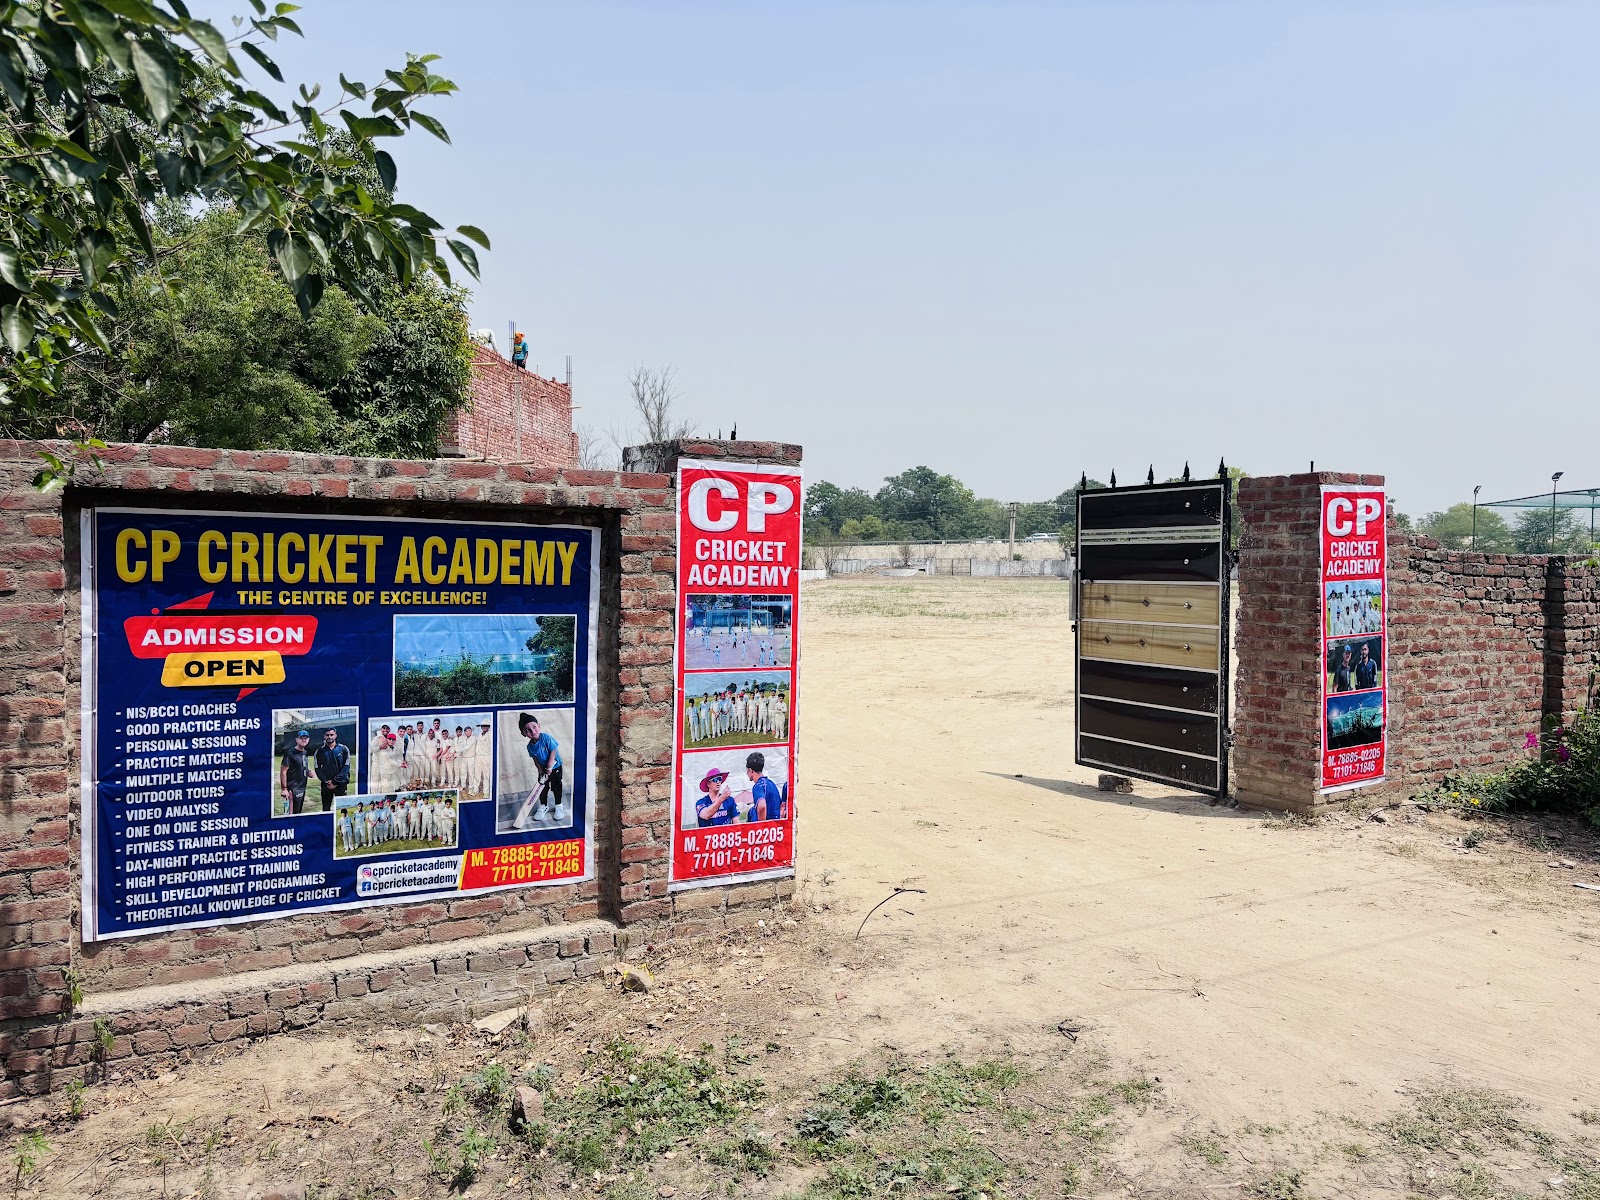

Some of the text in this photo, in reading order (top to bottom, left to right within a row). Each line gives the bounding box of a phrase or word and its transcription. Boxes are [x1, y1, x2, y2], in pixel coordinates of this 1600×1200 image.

[688, 477, 794, 533] CP
[1326, 497, 1382, 537] CP
[115, 527, 580, 586] CP CRICKET ACADEMY
[695, 538, 786, 562] CRICKET
[1330, 540, 1378, 558] CRICKET
[687, 564, 792, 587] ACADEMY
[1326, 558, 1382, 576] ACADEMY
[237, 590, 487, 606] THE CENTRE OF EXCELLENCE!
[140, 626, 304, 646] ADMISSION
[184, 659, 265, 678] OPEN
[126, 702, 237, 720] NIS/BCCI COACHES
[126, 718, 261, 736] GOOD PRACTICE AREAS
[126, 734, 247, 753] PERSONAL SESSIONS
[126, 752, 244, 770] PRACTICE MATCHES
[1328, 748, 1381, 767] M. 78885-02205
[126, 768, 242, 788] MULTIPLE MATCHES
[1333, 761, 1376, 778] 77101-71846
[126, 786, 225, 804] OUTDOOR TOURS
[126, 802, 220, 821] VIDEO ANALYSIS
[126, 816, 249, 838] ONE ON ONE SESSION
[126, 828, 295, 856] FITNESS TRAINER & DIETITIAN
[684, 826, 784, 852] M. 78885-02205
[126, 844, 304, 872] DAY-NIGHT PRACTICE SESSIONS
[471, 841, 580, 867] M. 78885-02205
[693, 845, 774, 870] 77101-71846
[126, 860, 300, 890] HIGH PERFORMANCE TRAINING
[372, 859, 458, 878] cpcricketacademy
[492, 858, 580, 882] 77101-71846
[126, 873, 326, 906] SKILL DEVELOPMENT PROGRAMMES
[372, 874, 458, 892] cpcricketacademy
[126, 886, 342, 923] THEORETICAL KNOWLEDGE OF CRICKET
